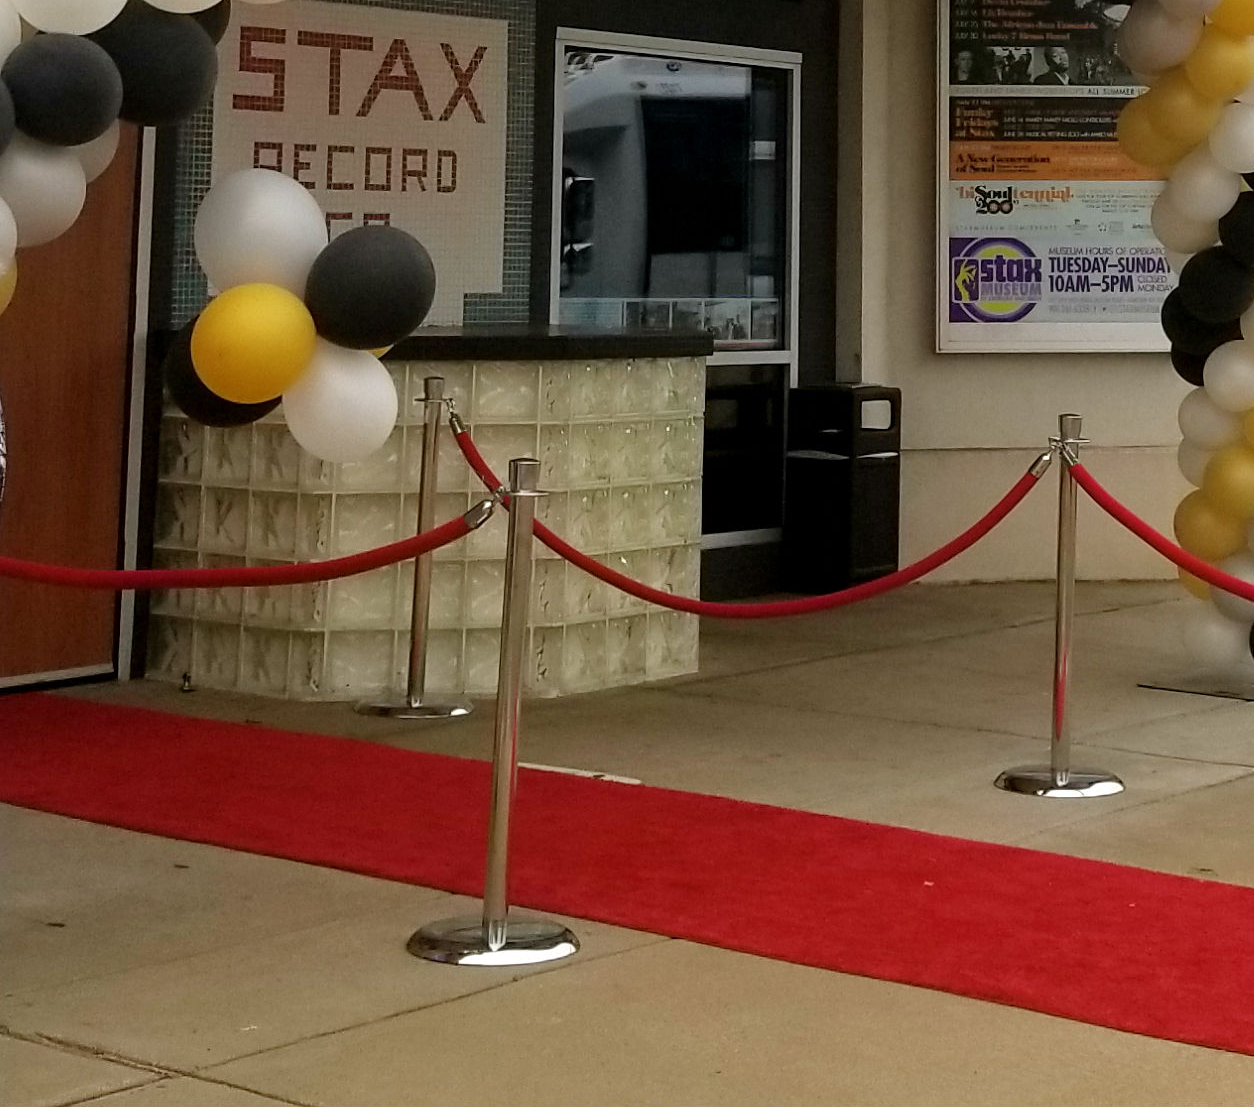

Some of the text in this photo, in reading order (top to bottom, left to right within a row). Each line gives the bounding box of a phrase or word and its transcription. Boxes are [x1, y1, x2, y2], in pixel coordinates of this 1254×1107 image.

[232, 26, 488, 124] STAX
[253, 141, 458, 194] RECORD
[1049, 247, 1084, 256] MUSEUM
[981, 254, 1042, 282] stax
[980, 283, 1042, 296] MUSEUM
